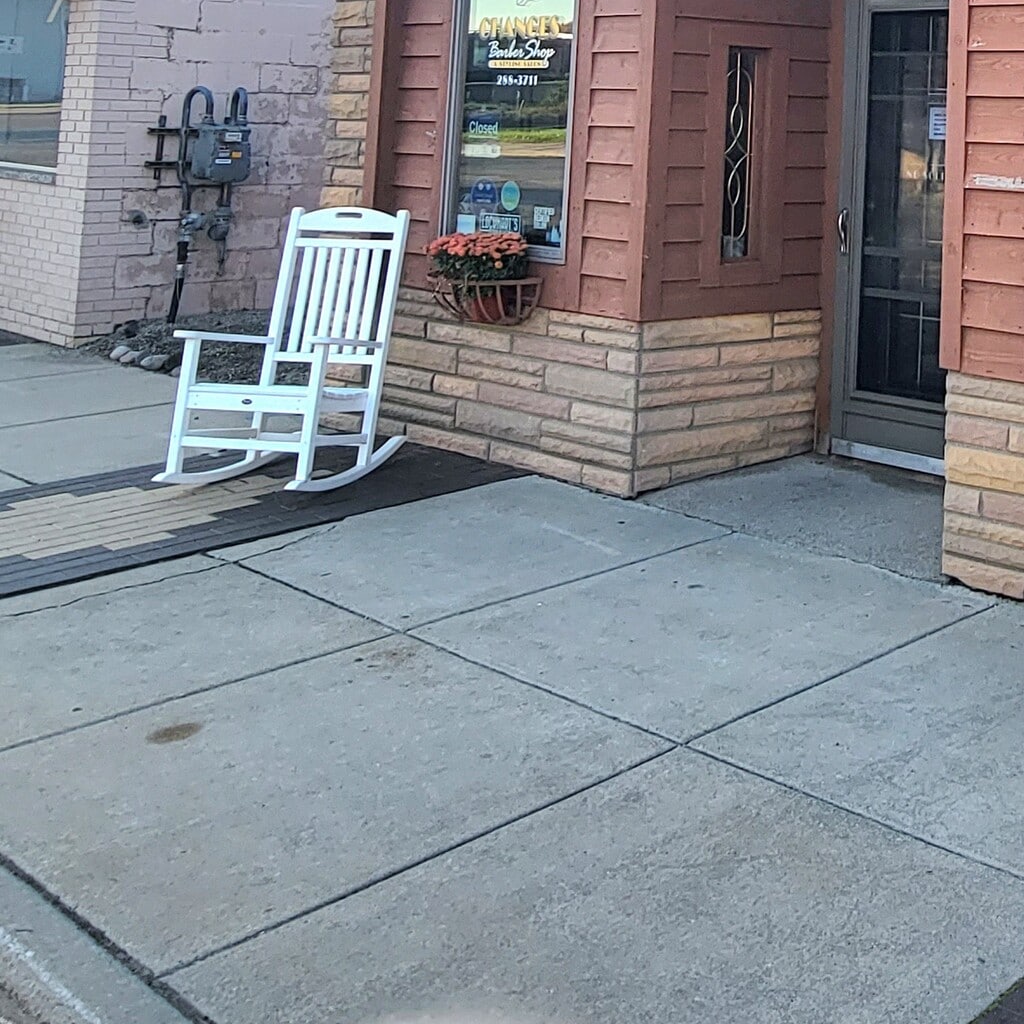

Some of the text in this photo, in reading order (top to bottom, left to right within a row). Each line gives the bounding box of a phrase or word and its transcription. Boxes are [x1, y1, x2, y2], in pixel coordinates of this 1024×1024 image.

[479, 15, 560, 40] CHANGES
[488, 39, 555, 66] Barber Shop
[469, 121, 499, 134] Closed
